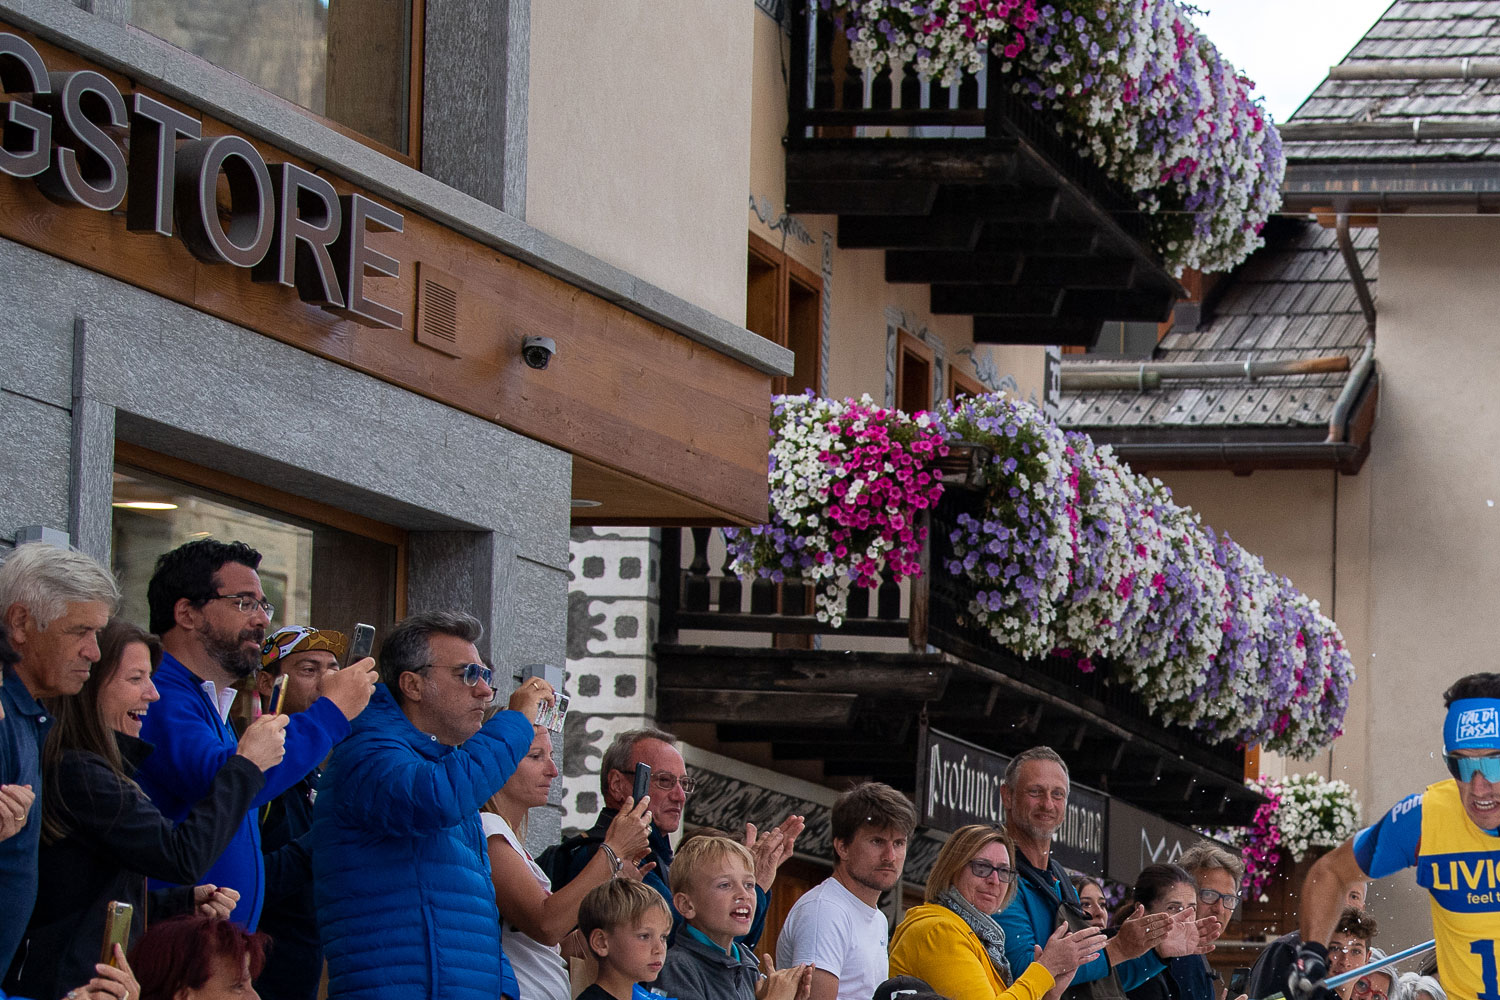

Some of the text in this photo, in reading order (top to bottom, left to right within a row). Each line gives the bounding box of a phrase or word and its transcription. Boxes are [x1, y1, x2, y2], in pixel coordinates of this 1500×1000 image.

[1461, 709, 1494, 725] VAL DI
[1460, 721, 1495, 738] FASSA
[1467, 891, 1494, 904] feel
